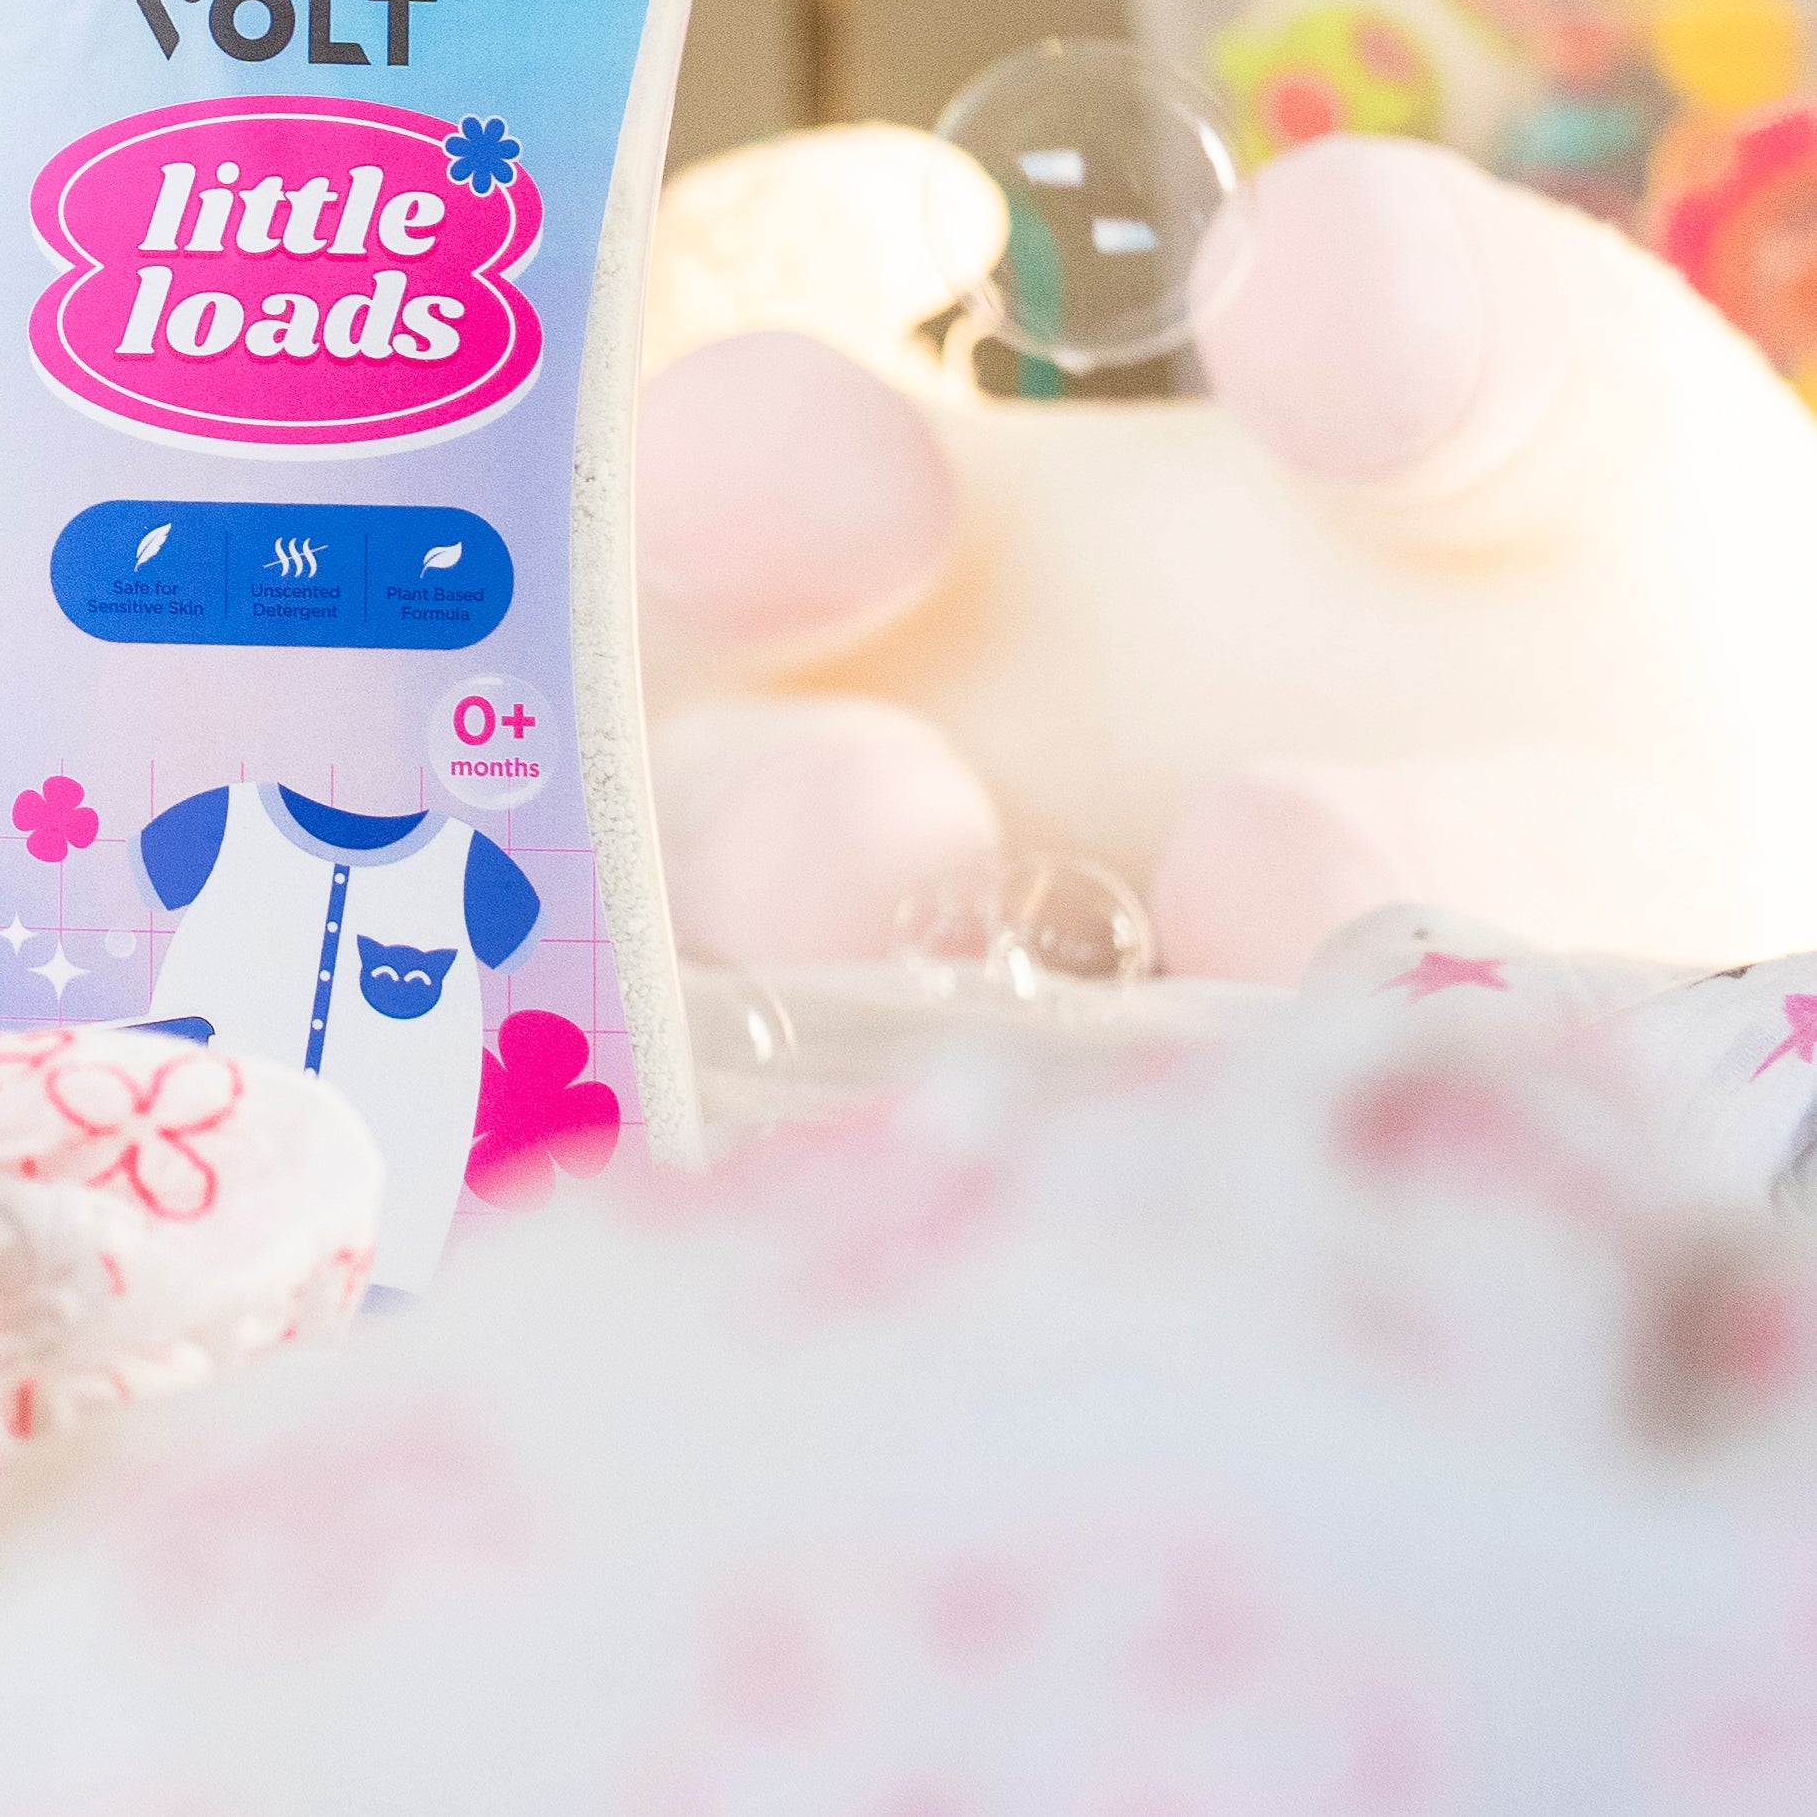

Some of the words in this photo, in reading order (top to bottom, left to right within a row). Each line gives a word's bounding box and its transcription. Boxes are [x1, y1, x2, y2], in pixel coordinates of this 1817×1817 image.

[137, 161, 445, 256] little
[115, 265, 465, 361] loads
[112, 579, 149, 596] Safe
[155, 580, 179, 595] for
[251, 583, 341, 600] Unscented
[387, 585, 429, 602] Plant
[433, 586, 484, 603] Based
[86, 599, 163, 616] Sensitive
[168, 600, 204, 617] Skin
[252, 602, 338, 620] Detergent
[401, 605, 470, 622] Formula
[453, 695, 536, 746] 0+
[450, 757, 540, 778] months
